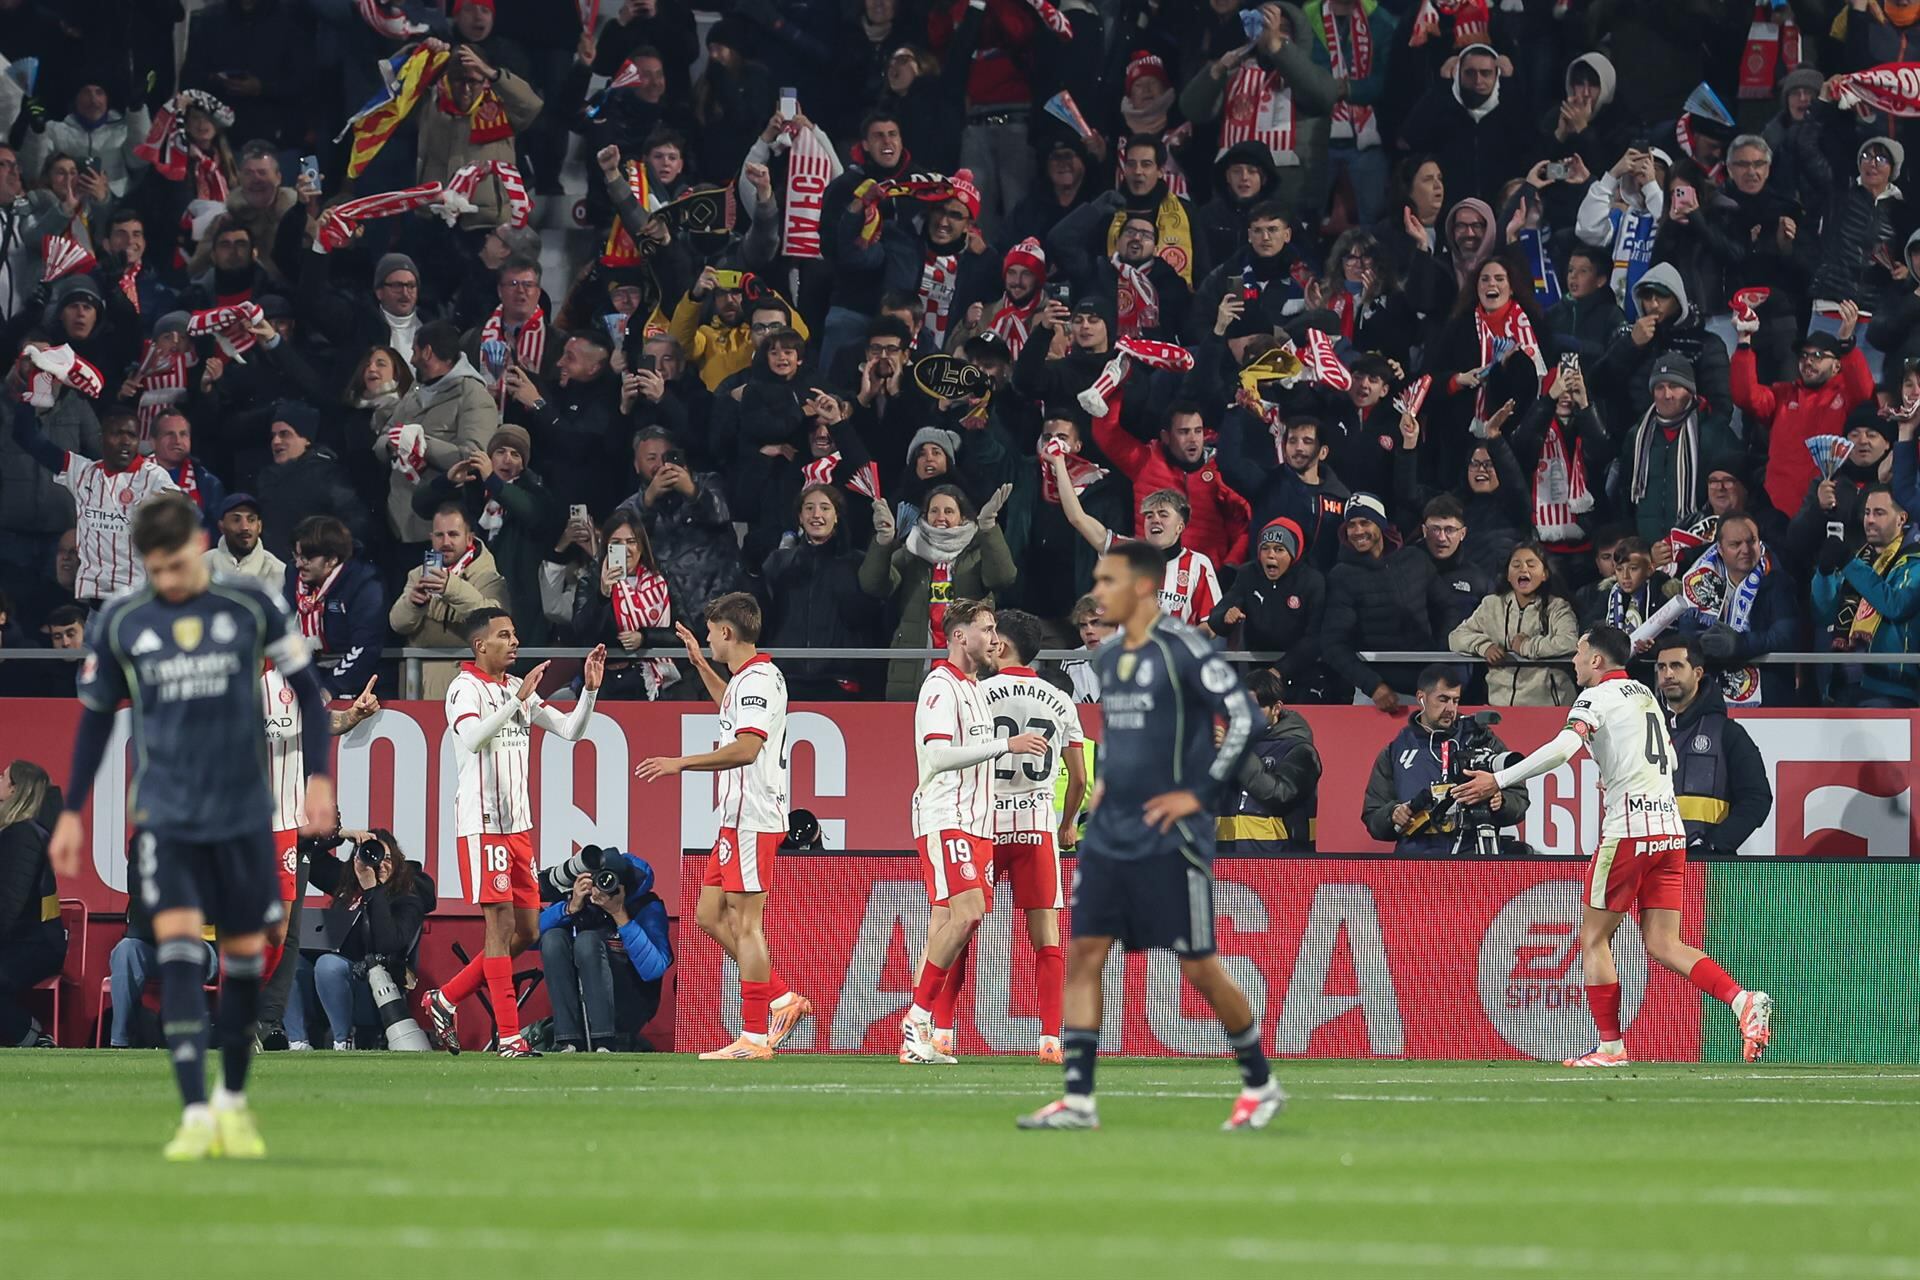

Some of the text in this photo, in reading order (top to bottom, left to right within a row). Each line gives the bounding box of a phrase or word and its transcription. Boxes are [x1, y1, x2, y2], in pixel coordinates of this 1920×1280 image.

[1158, 590, 1188, 604] THON
[1013, 684, 1067, 717] MARTIN
[969, 725, 993, 736] ETIH
[1645, 712, 1668, 775] 4
[994, 716, 1057, 781] 23
[995, 797, 1037, 811] arlex
[1629, 797, 1674, 813] Marlex
[484, 844, 508, 872] 18
[945, 838, 972, 864] 19
[1507, 983, 1582, 1009] SPOR
